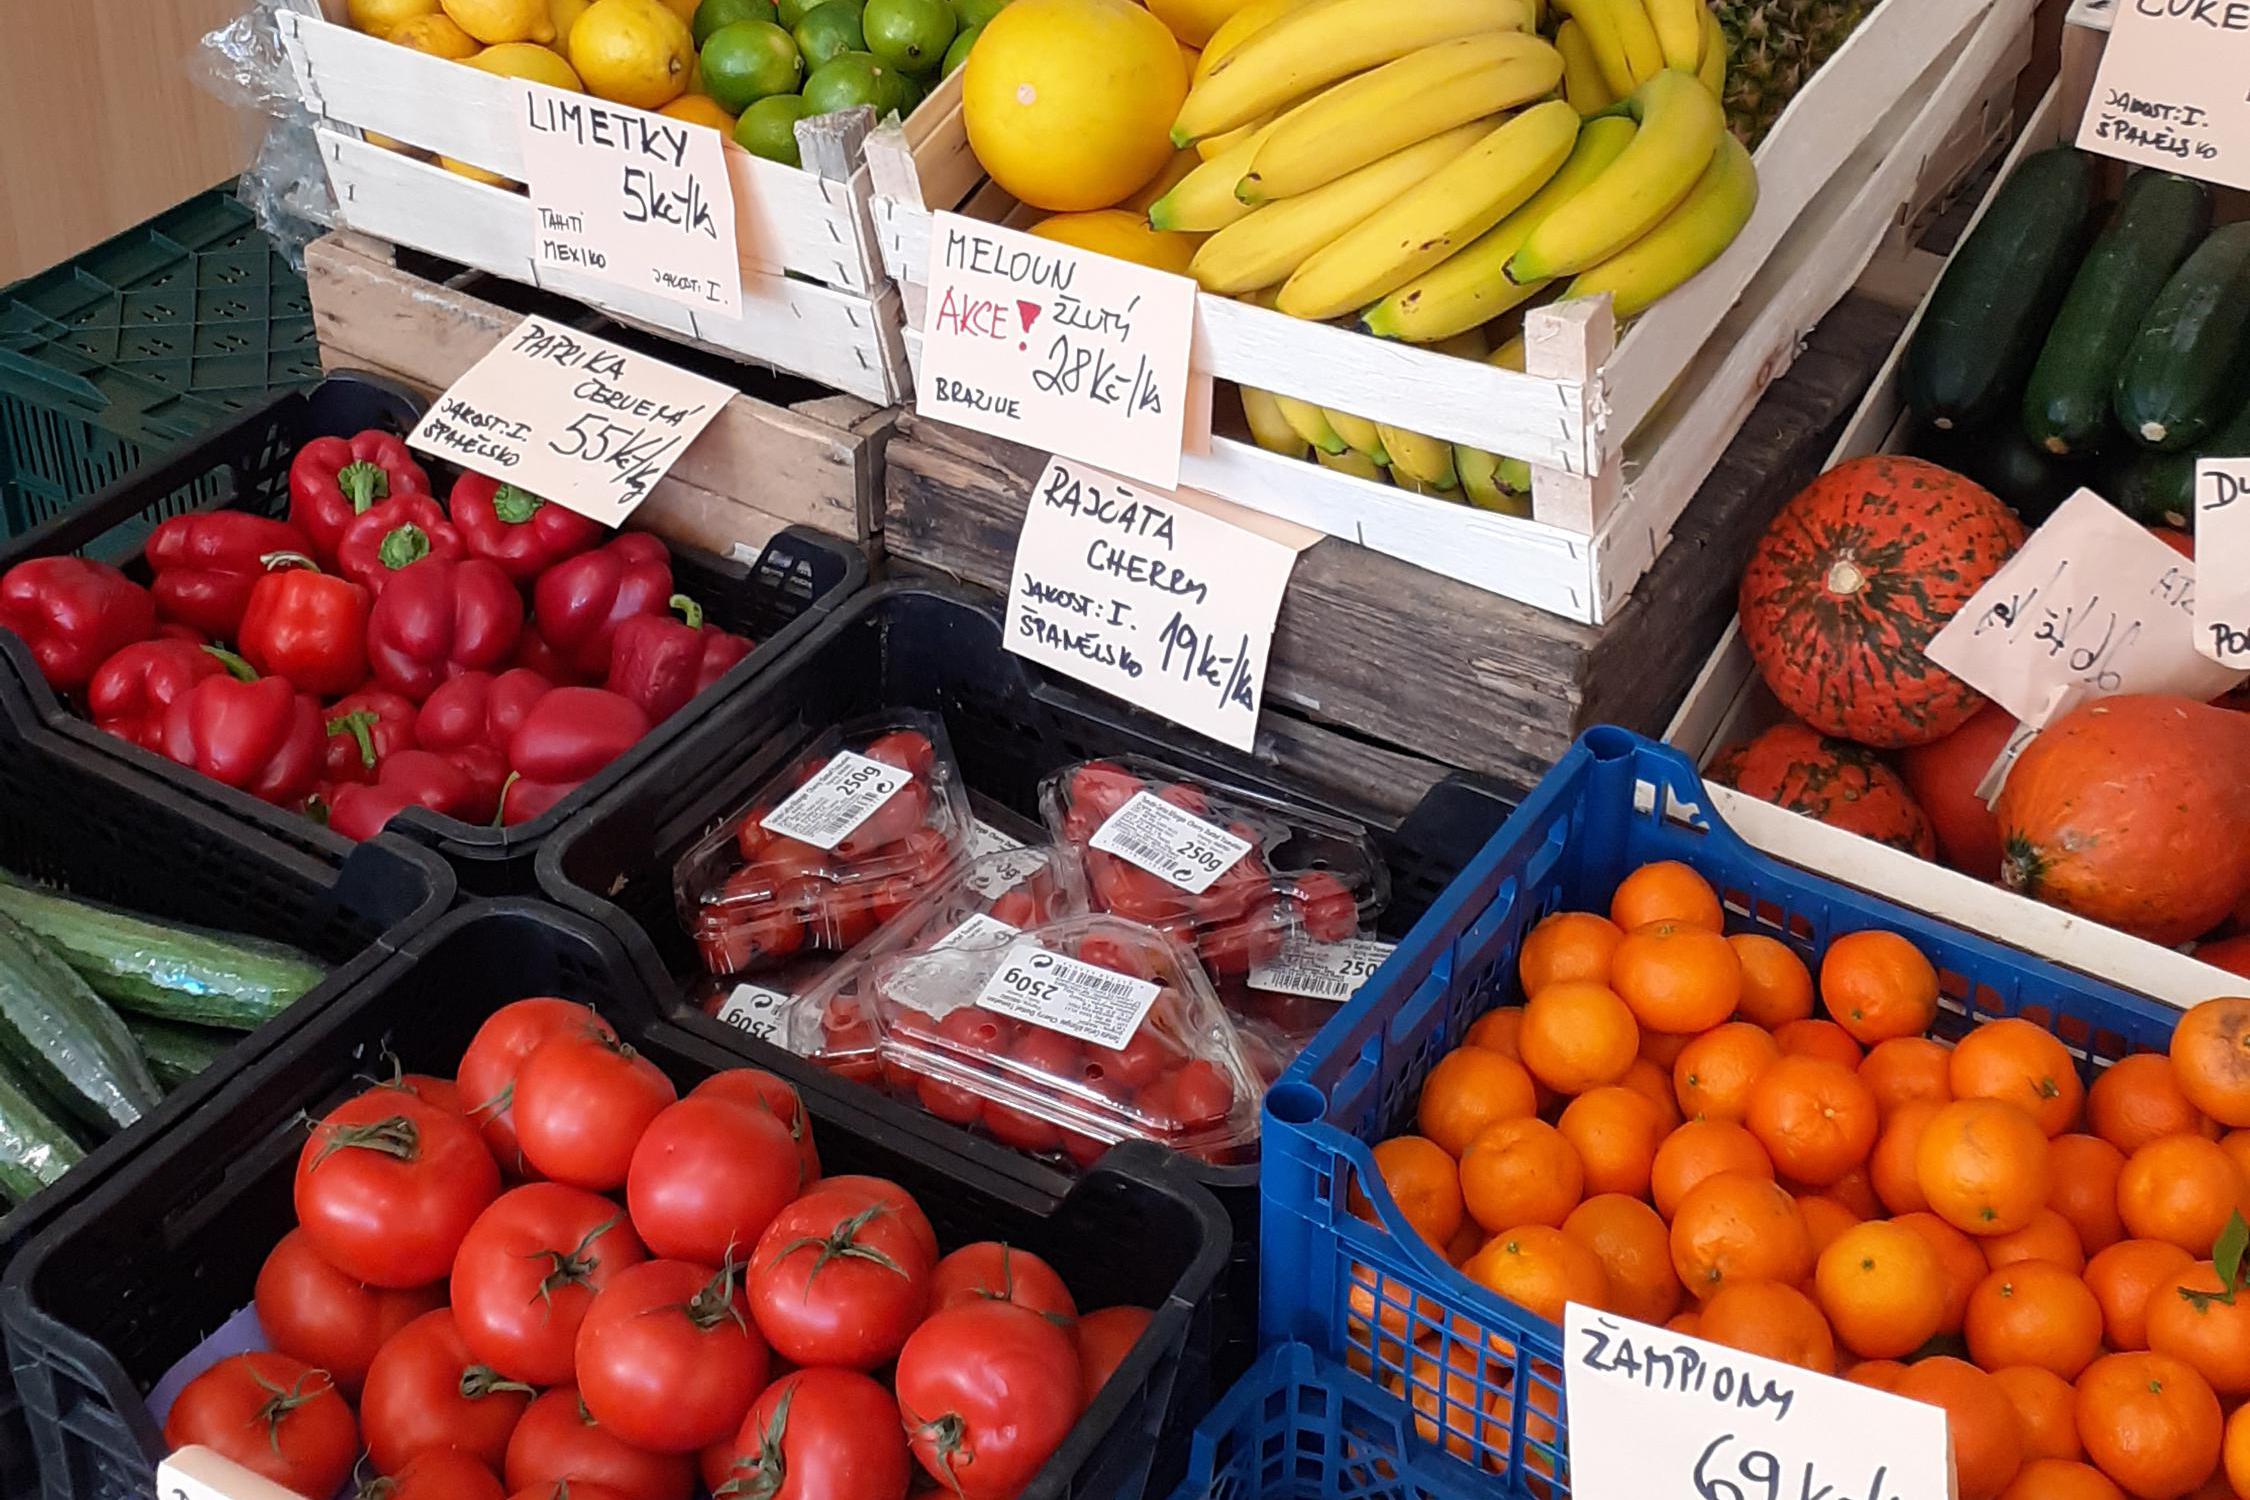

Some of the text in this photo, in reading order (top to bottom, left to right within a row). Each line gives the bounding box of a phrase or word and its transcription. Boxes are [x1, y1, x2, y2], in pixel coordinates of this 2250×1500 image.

[527, 91, 688, 167] LIMETKY
[543, 239, 607, 268] MEXIKO
[946, 229, 1076, 290] MELOUN
[1053, 294, 1141, 342] ŽLUTÝ
[512, 324, 626, 380] PAPRIKA
[574, 377, 706, 428] ČERVENÁ
[1044, 466, 1174, 551] RAJČATA
[1086, 539, 1207, 605] CHERRY
[836, 766, 881, 796] 250g
[1177, 841, 1223, 872] 250g
[1003, 967, 1059, 1001] 250g
[726, 1008, 777, 1040] 250g
[1581, 1317, 1795, 1422] ŽAMPIONY
